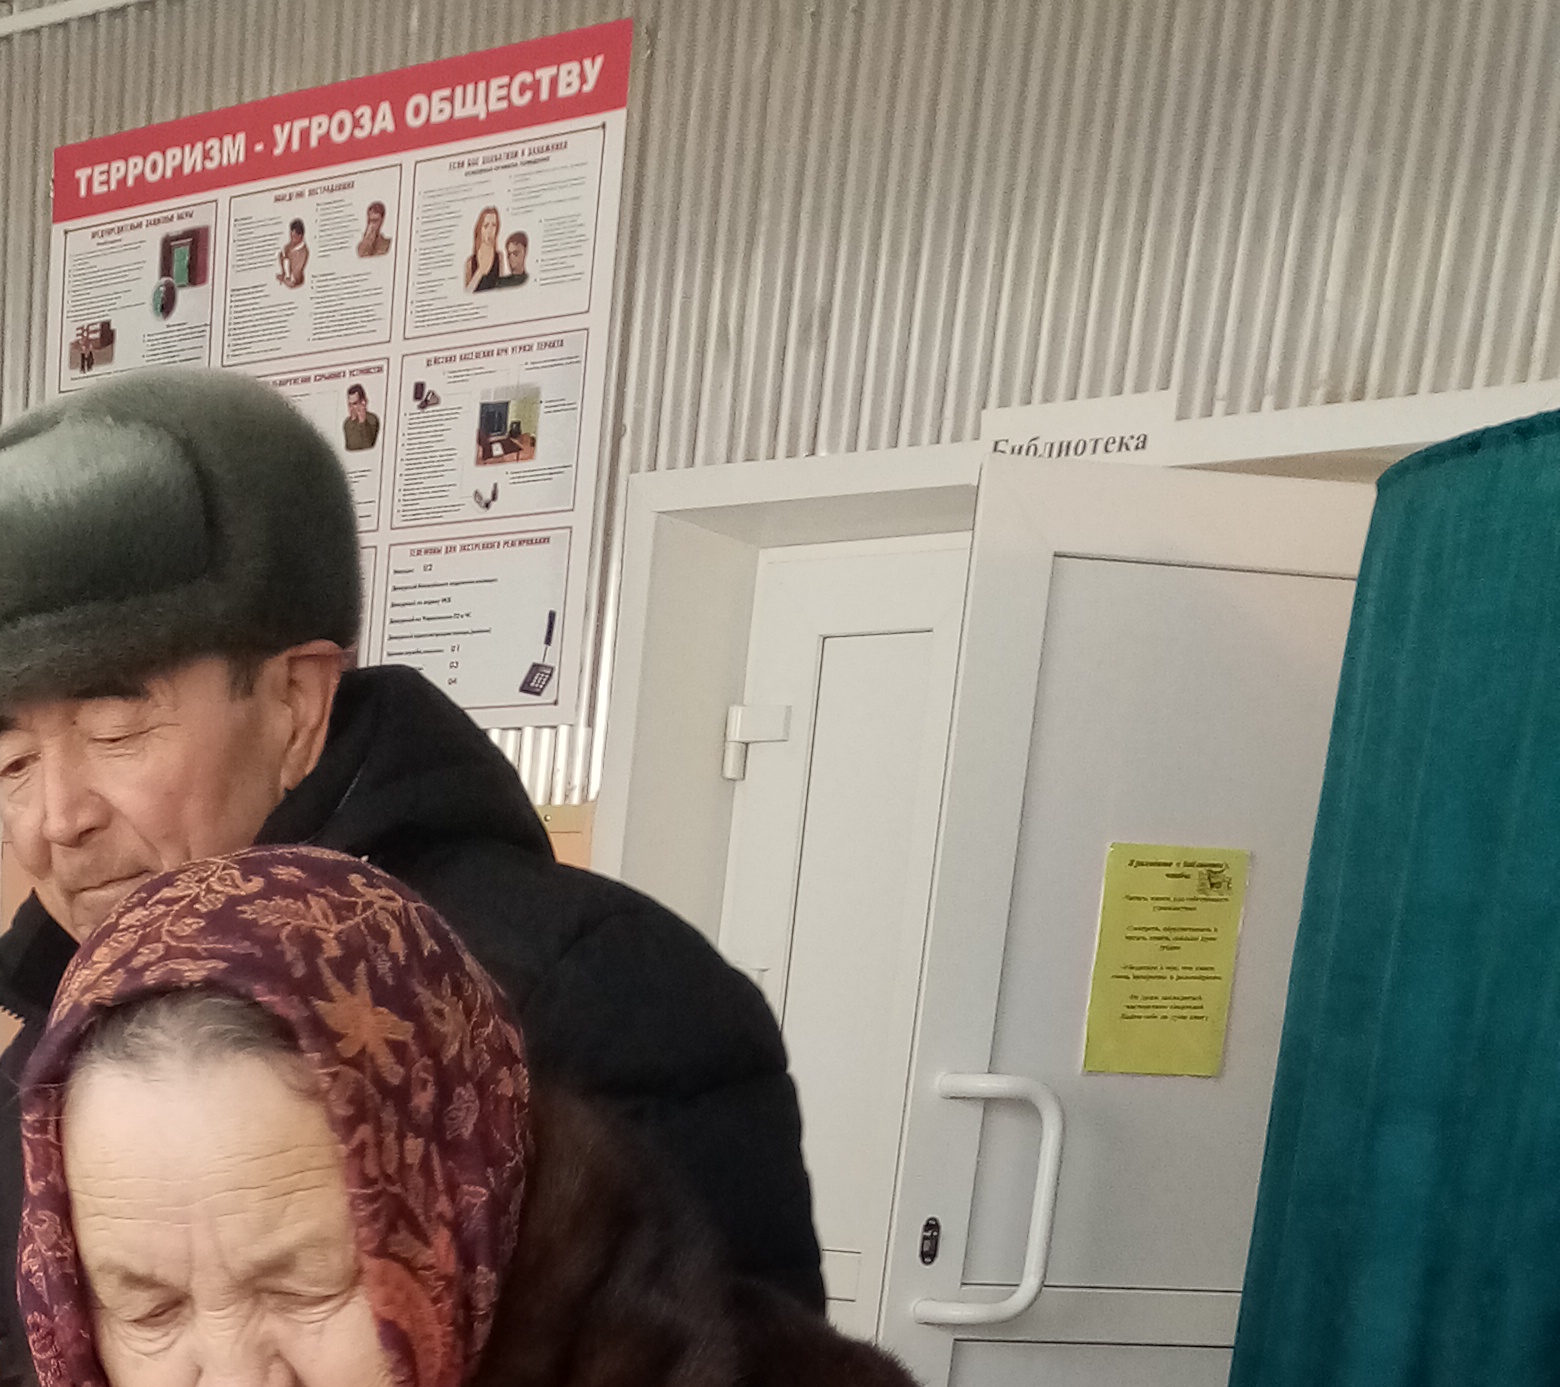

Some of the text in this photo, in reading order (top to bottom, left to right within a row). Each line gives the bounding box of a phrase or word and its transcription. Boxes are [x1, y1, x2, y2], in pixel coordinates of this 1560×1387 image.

[74, 131, 245, 198] ТЕРРОРИЗМ
[254, 142, 265, 154] -
[272, 102, 395, 156] УГРОЗА
[404, 54, 604, 128] ОБЩЕСТВУ
[993, 432, 1147, 459] Библиотека
